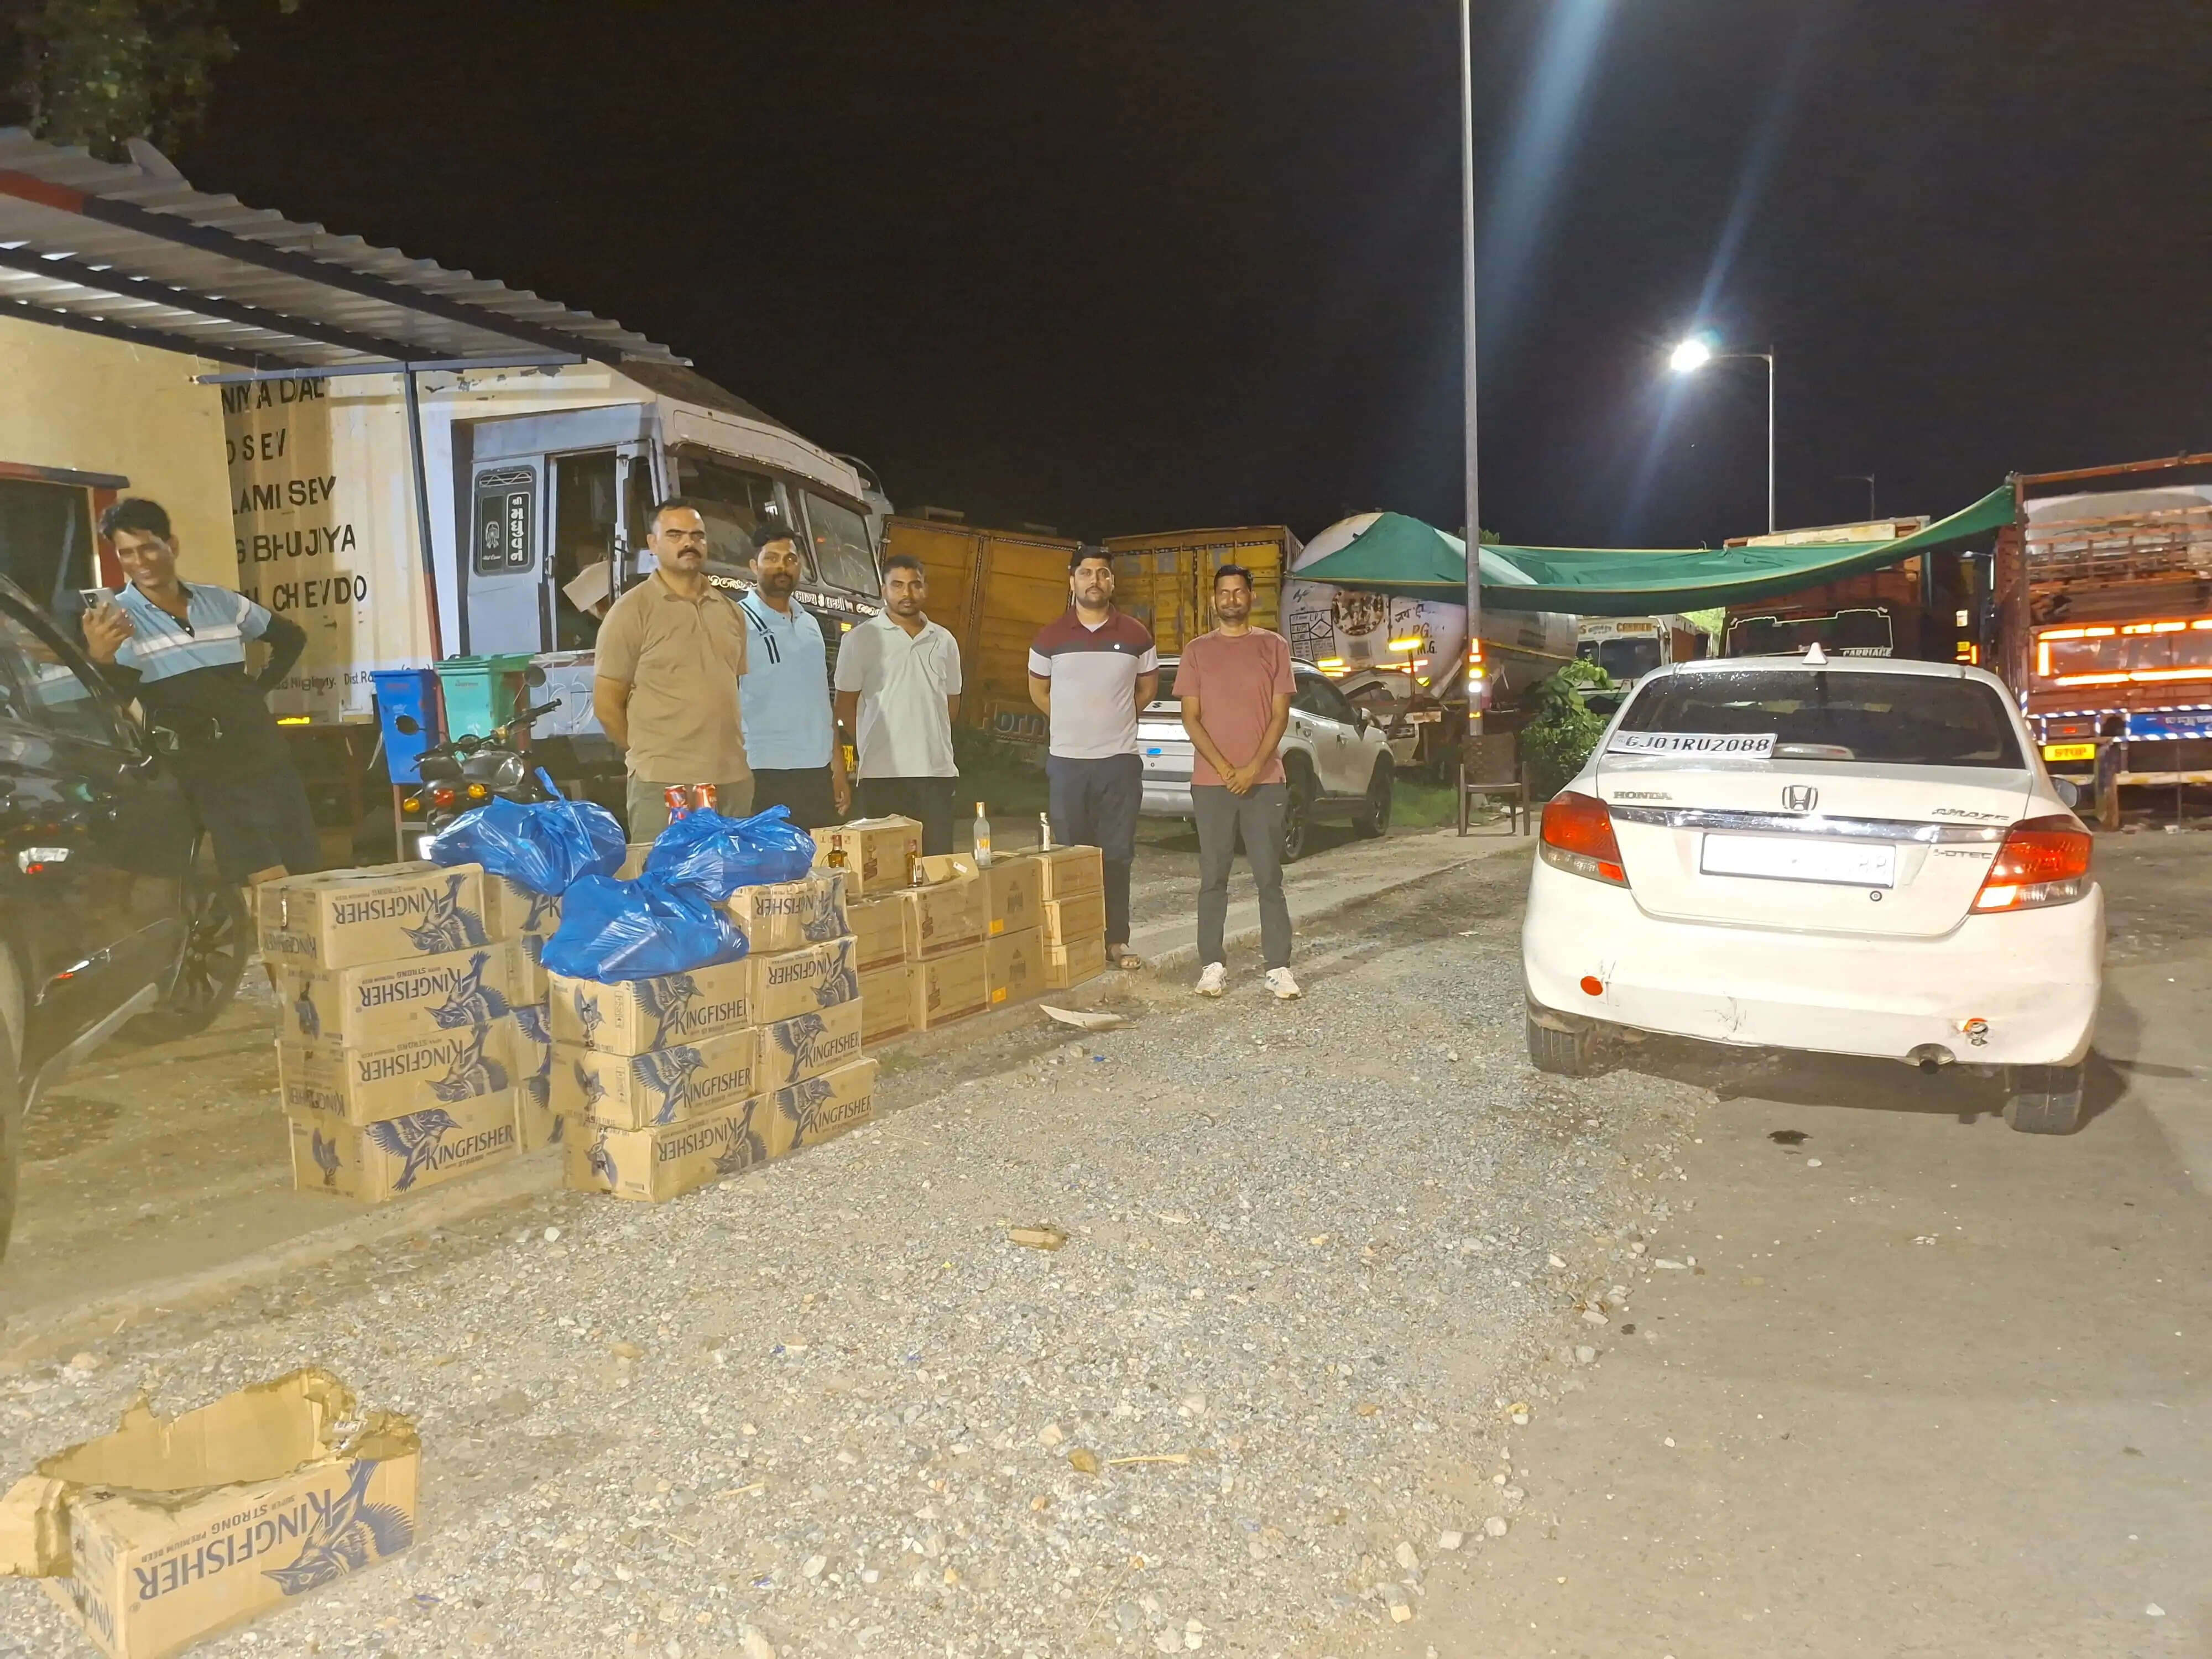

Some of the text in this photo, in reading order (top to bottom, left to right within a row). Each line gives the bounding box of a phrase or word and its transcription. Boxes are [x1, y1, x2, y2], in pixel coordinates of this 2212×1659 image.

[243, 429, 285, 461] SEV
[233, 476, 336, 514] AMI SEV
[253, 524, 356, 562] BHUJIYA
[273, 575, 367, 612] CHEVDO
[1626, 735, 1770, 752] GJ01RU2088
[2054, 747, 2086, 757] STOP
[1613, 791, 1673, 800] HONDA
[1932, 808, 2010, 821] AMAZE
[332, 887, 440, 925] KINGFISHER
[754, 890, 824, 916] KNGFISHER
[358, 967, 462, 1007] KINGFISHER
[396, 967, 426, 979] STRONG
[768, 952, 833, 985] KINGFISHER
[357, 1038, 465, 1082] KINGFISHER
[805, 1031, 860, 1068] KINGFISHER
[682, 1067, 752, 1108] KINGFISHER
[809, 1095, 872, 1133] KINGFISHER
[425, 1124, 514, 1171] KINGFISHER
[656, 1117, 737, 1162] KINGFISHER
[211, 1504, 268, 1535] STRONG
[132, 1488, 333, 1601] KINGFISHER
[140, 1548, 165, 1563] BEER
[165, 1530, 207, 1554] PREMIUM
